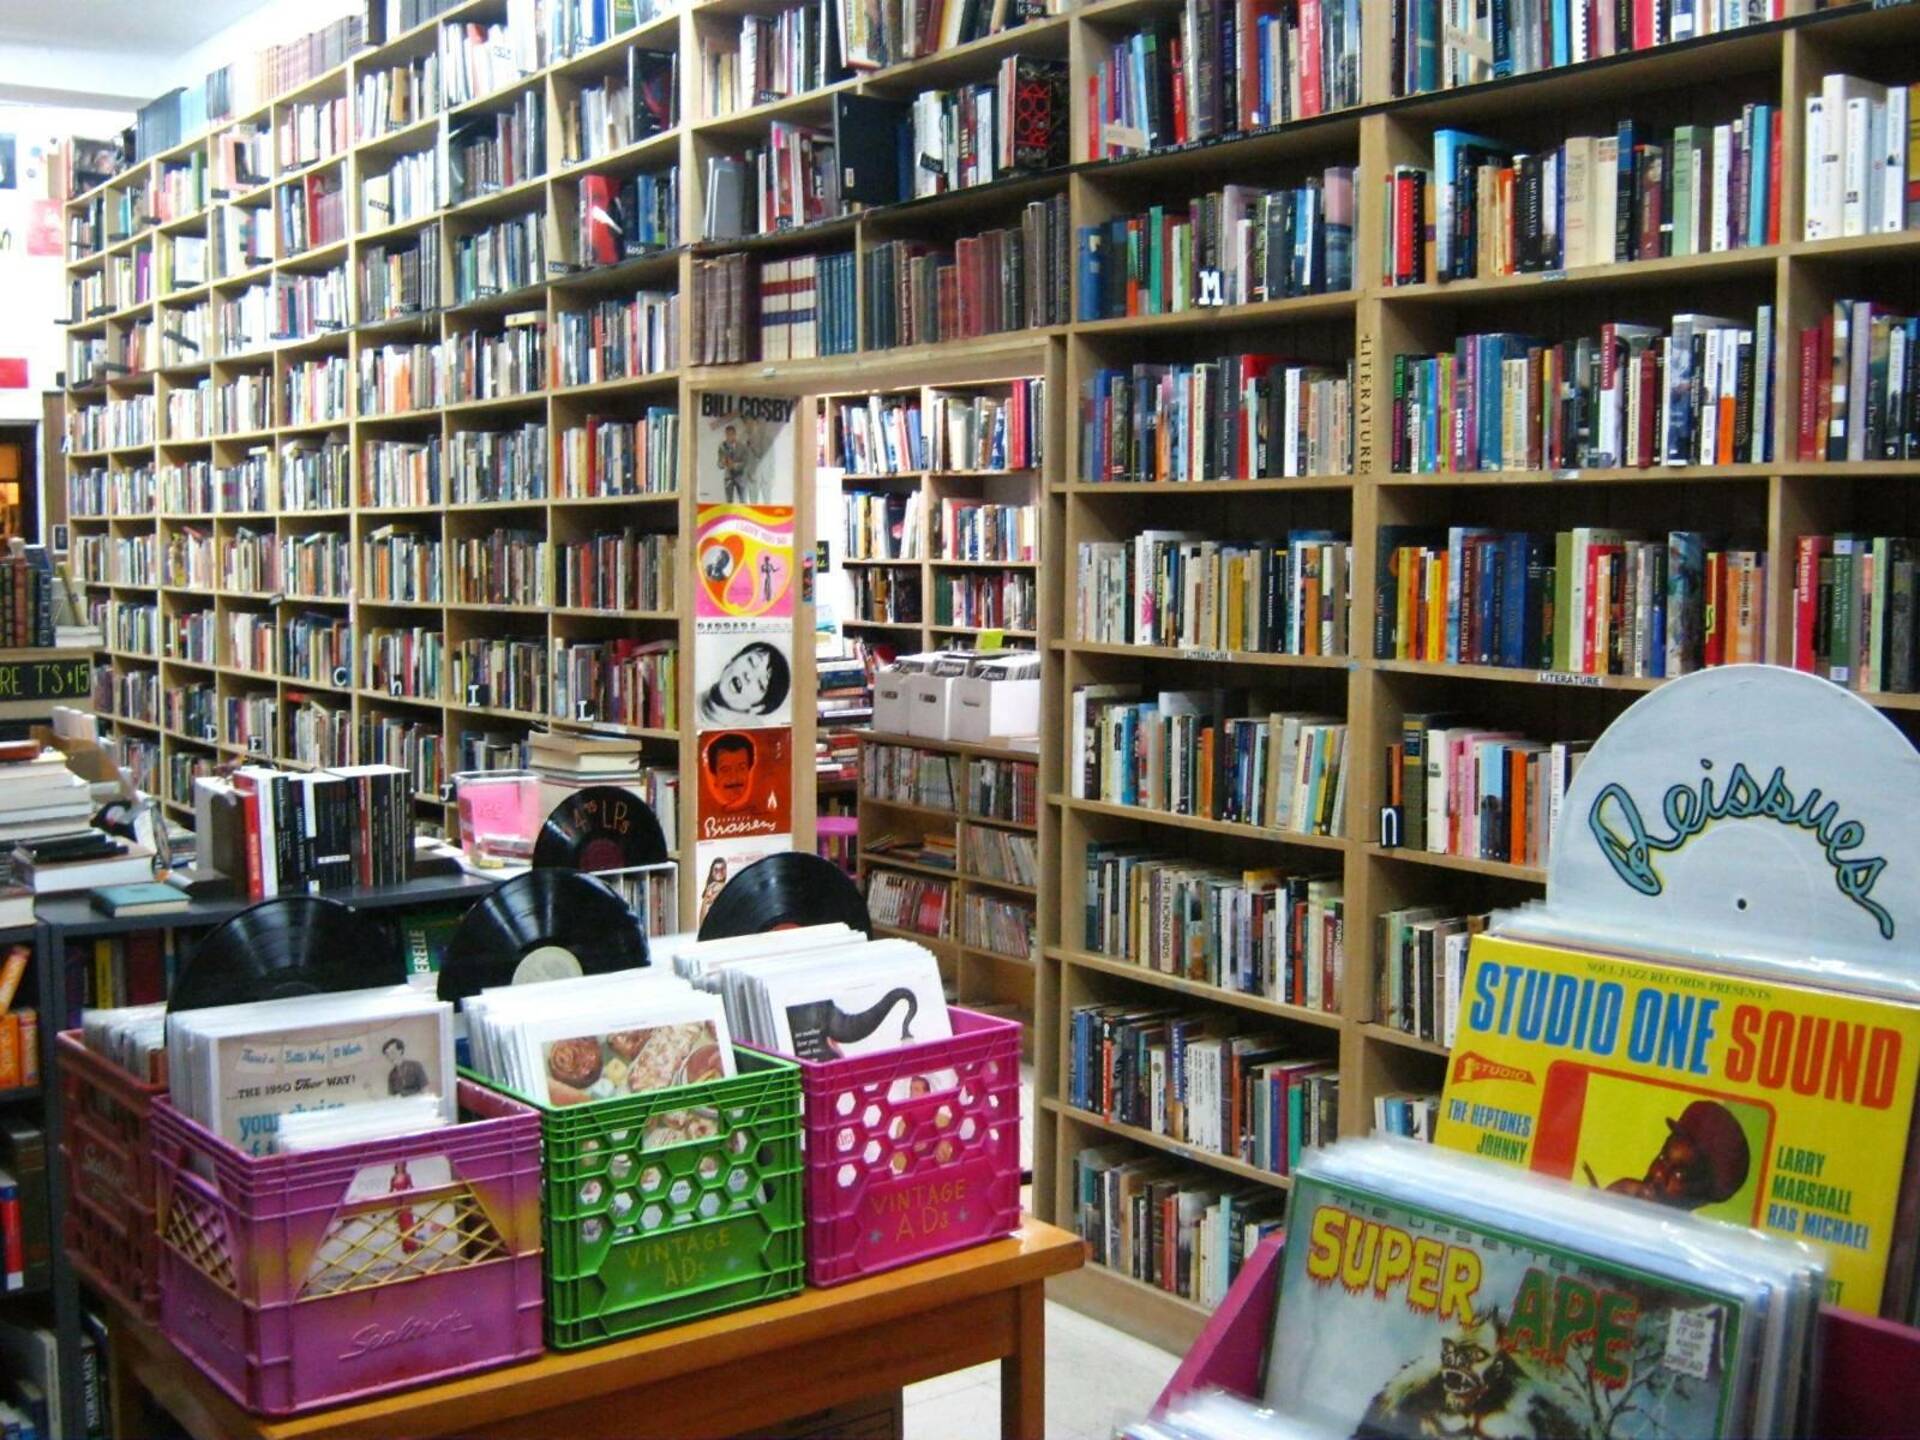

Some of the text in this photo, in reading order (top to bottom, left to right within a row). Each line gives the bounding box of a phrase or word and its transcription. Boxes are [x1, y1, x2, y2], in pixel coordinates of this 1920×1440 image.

[1529, 177, 1537, 239] IMPRIMATUR
[1199, 270, 1223, 305] M
[702, 393, 793, 422] BILL COSBY
[1360, 338, 1373, 470] LITERATURE
[1455, 408, 1463, 456] MOORE
[1460, 596, 1470, 652] SEPULCHRE
[34, 663, 64, 694] T'S
[333, 667, 346, 686] C
[468, 685, 480, 706] I
[1540, 672, 1600, 686] LITERATURE
[577, 700, 594, 722] L
[206, 725, 218, 743] D
[250, 736, 261, 752] E
[704, 816, 776, 838] Brassens
[1589, 758, 1894, 941] Reissues
[1162, 877, 1171, 959] THE THORN BIRDS
[1587, 961, 1771, 1000] SOUL JAZZ RECORDS PRESENTS
[1468, 961, 1903, 1110] STUDIO ONE SOUND
[265, 1082, 292, 1096] 1950
[1448, 1098, 1532, 1138] THE HEPTONES
[1476, 1132, 1528, 1164] JOHNNY
[1776, 1145, 1826, 1178] LARRY
[871, 1178, 966, 1217] VINTAGE
[1332, 1193, 1390, 1219] THE
[1772, 1177, 1852, 1215] MARSHALL
[1766, 1205, 1871, 1251] RAS MICHAEL
[626, 1227, 732, 1268] VINTAGE
[1306, 1206, 1482, 1328] SUPER
[1503, 1267, 1641, 1390] APE
